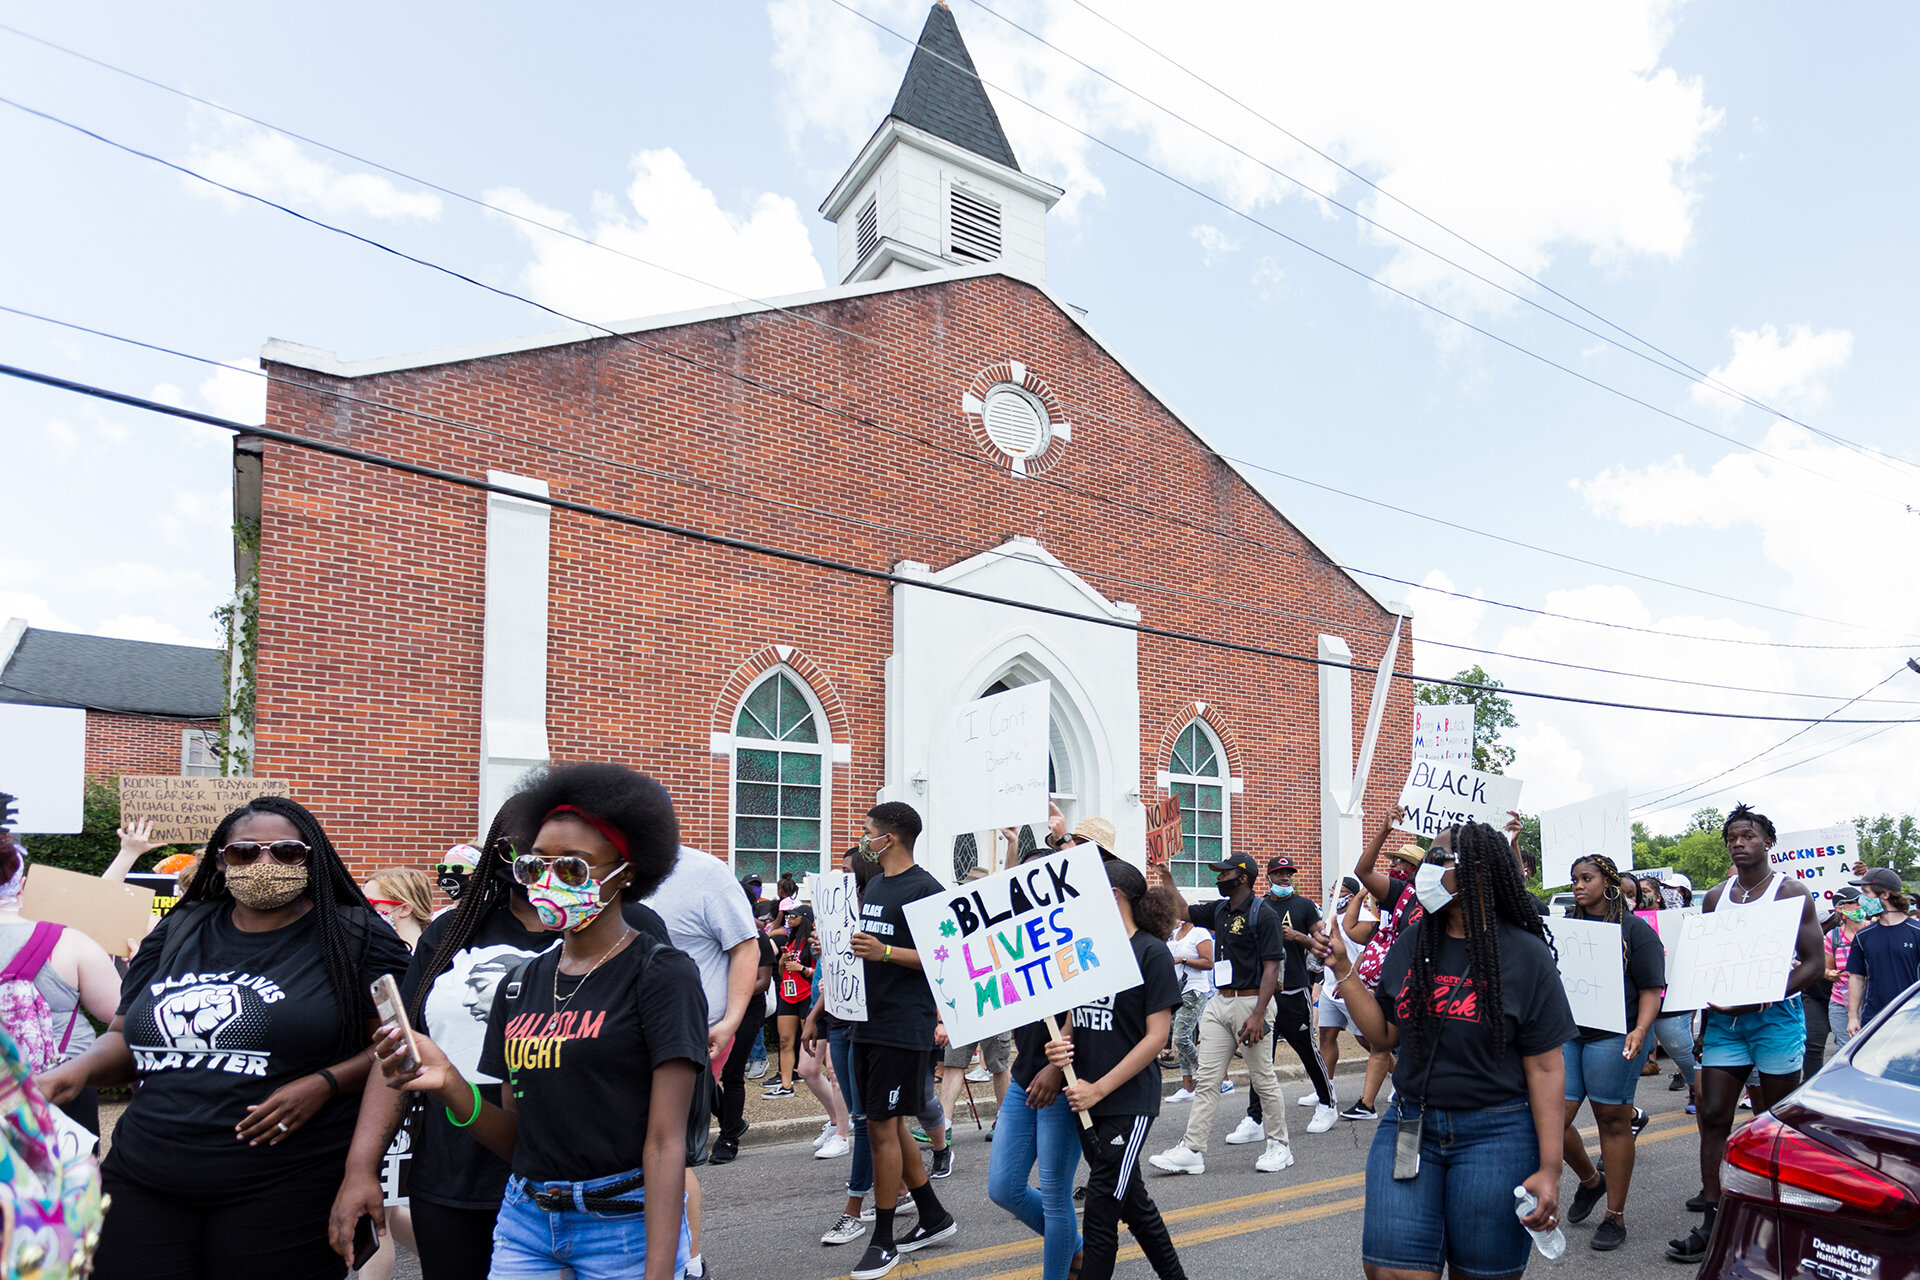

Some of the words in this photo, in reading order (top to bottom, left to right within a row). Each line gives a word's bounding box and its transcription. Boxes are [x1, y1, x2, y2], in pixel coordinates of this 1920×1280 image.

[122, 789, 151, 800] ERIC
[155, 789, 206, 800] GARNER
[213, 790, 251, 800] TAMIR
[123, 777, 169, 789] RODNEY
[173, 778, 200, 789] KING
[209, 778, 259, 790] TRAYVON
[1412, 761, 1487, 804] BLACK
[124, 800, 178, 811] MICHAEL
[181, 801, 217, 812] BROWN
[176, 814, 220, 824] CASTILE
[1147, 804, 1162, 832] NO
[1426, 794, 1475, 822] Lives
[1149, 834, 1163, 861] NO
[1770, 844, 1846, 864] BLACKNESS
[1796, 866, 1825, 880] NOT
[1840, 862, 1851, 873] A
[812, 876, 857, 928] lack
[862, 903, 884, 917] BLACK
[865, 920, 895, 936] MATTER
[962, 907, 1074, 981] LIVES
[151, 971, 236, 997] BLACK
[233, 973, 285, 1004] LIVES
[974, 937, 1101, 1018] MATTER
[1564, 975, 1602, 1001] oot
[504, 1010, 607, 1040] MALCOLM
[133, 1051, 268, 1077] MATTER
